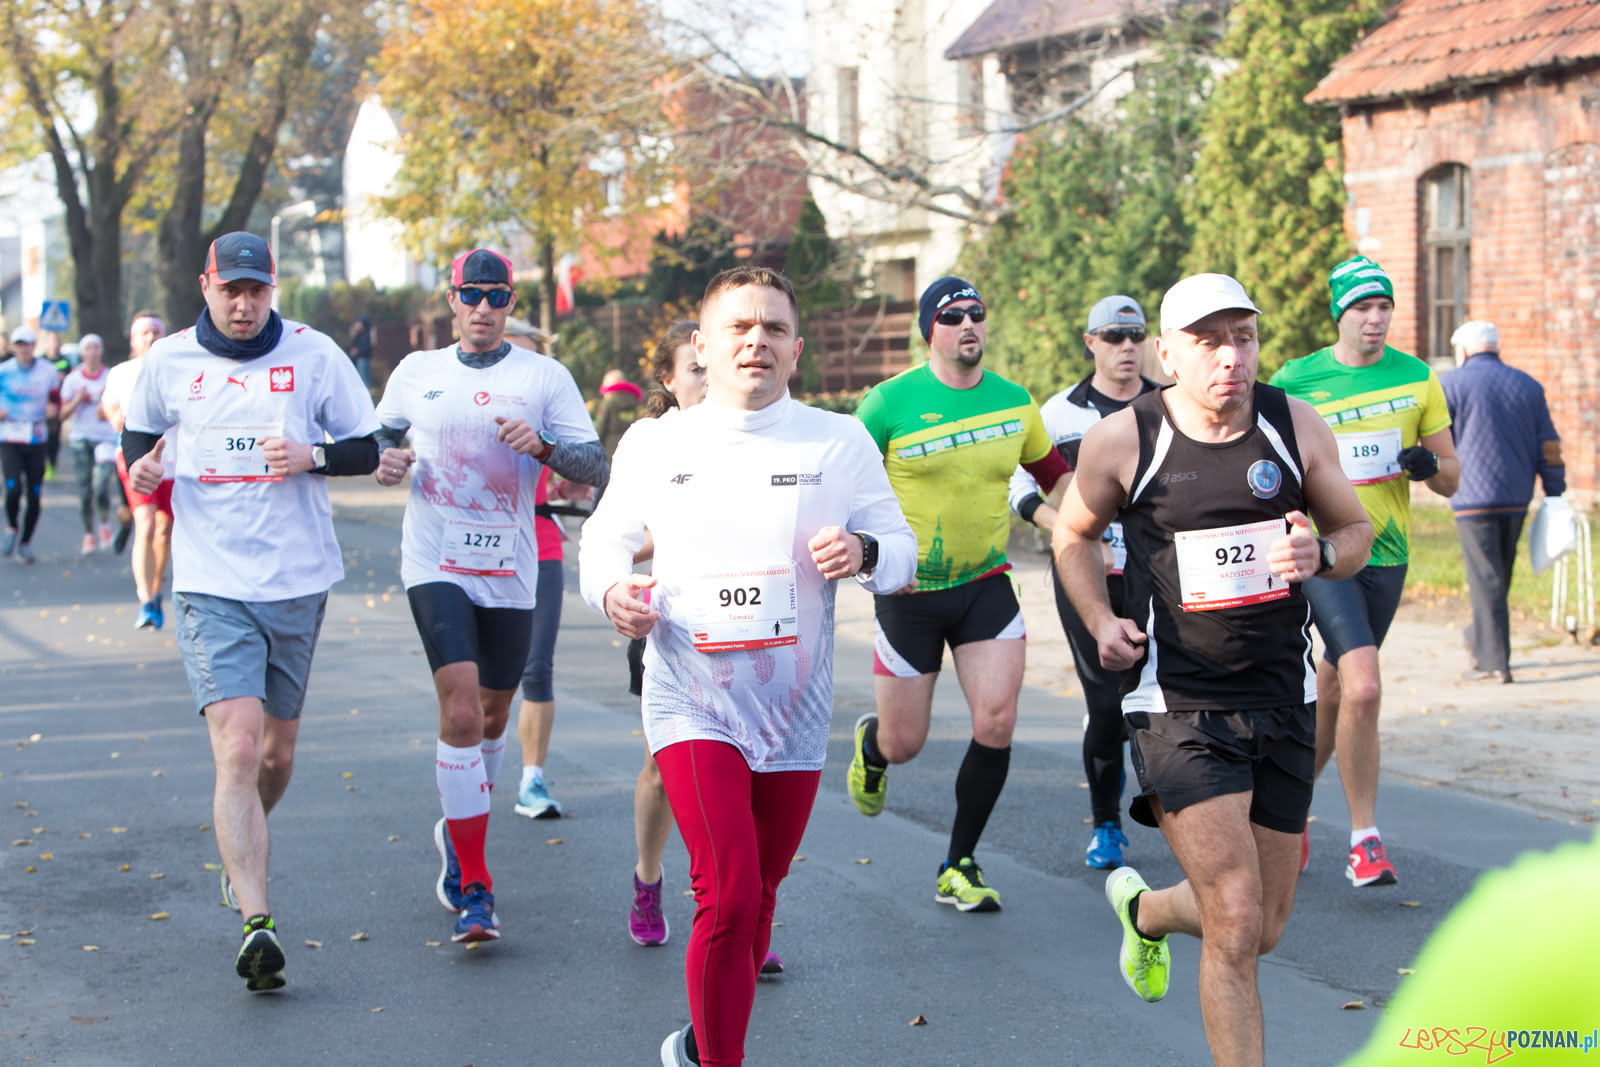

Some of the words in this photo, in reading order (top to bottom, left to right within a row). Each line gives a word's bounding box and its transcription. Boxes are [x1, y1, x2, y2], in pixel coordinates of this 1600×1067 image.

[424, 390, 444, 400] 4F
[225, 437, 256, 451] 367
[1352, 444, 1379, 457] 189
[670, 474, 693, 484] 4F
[464, 533, 501, 548] 1272
[1216, 544, 1256, 566] 922
[1220, 568, 1256, 579] KRZYSZTOF
[719, 587, 761, 607] 902
